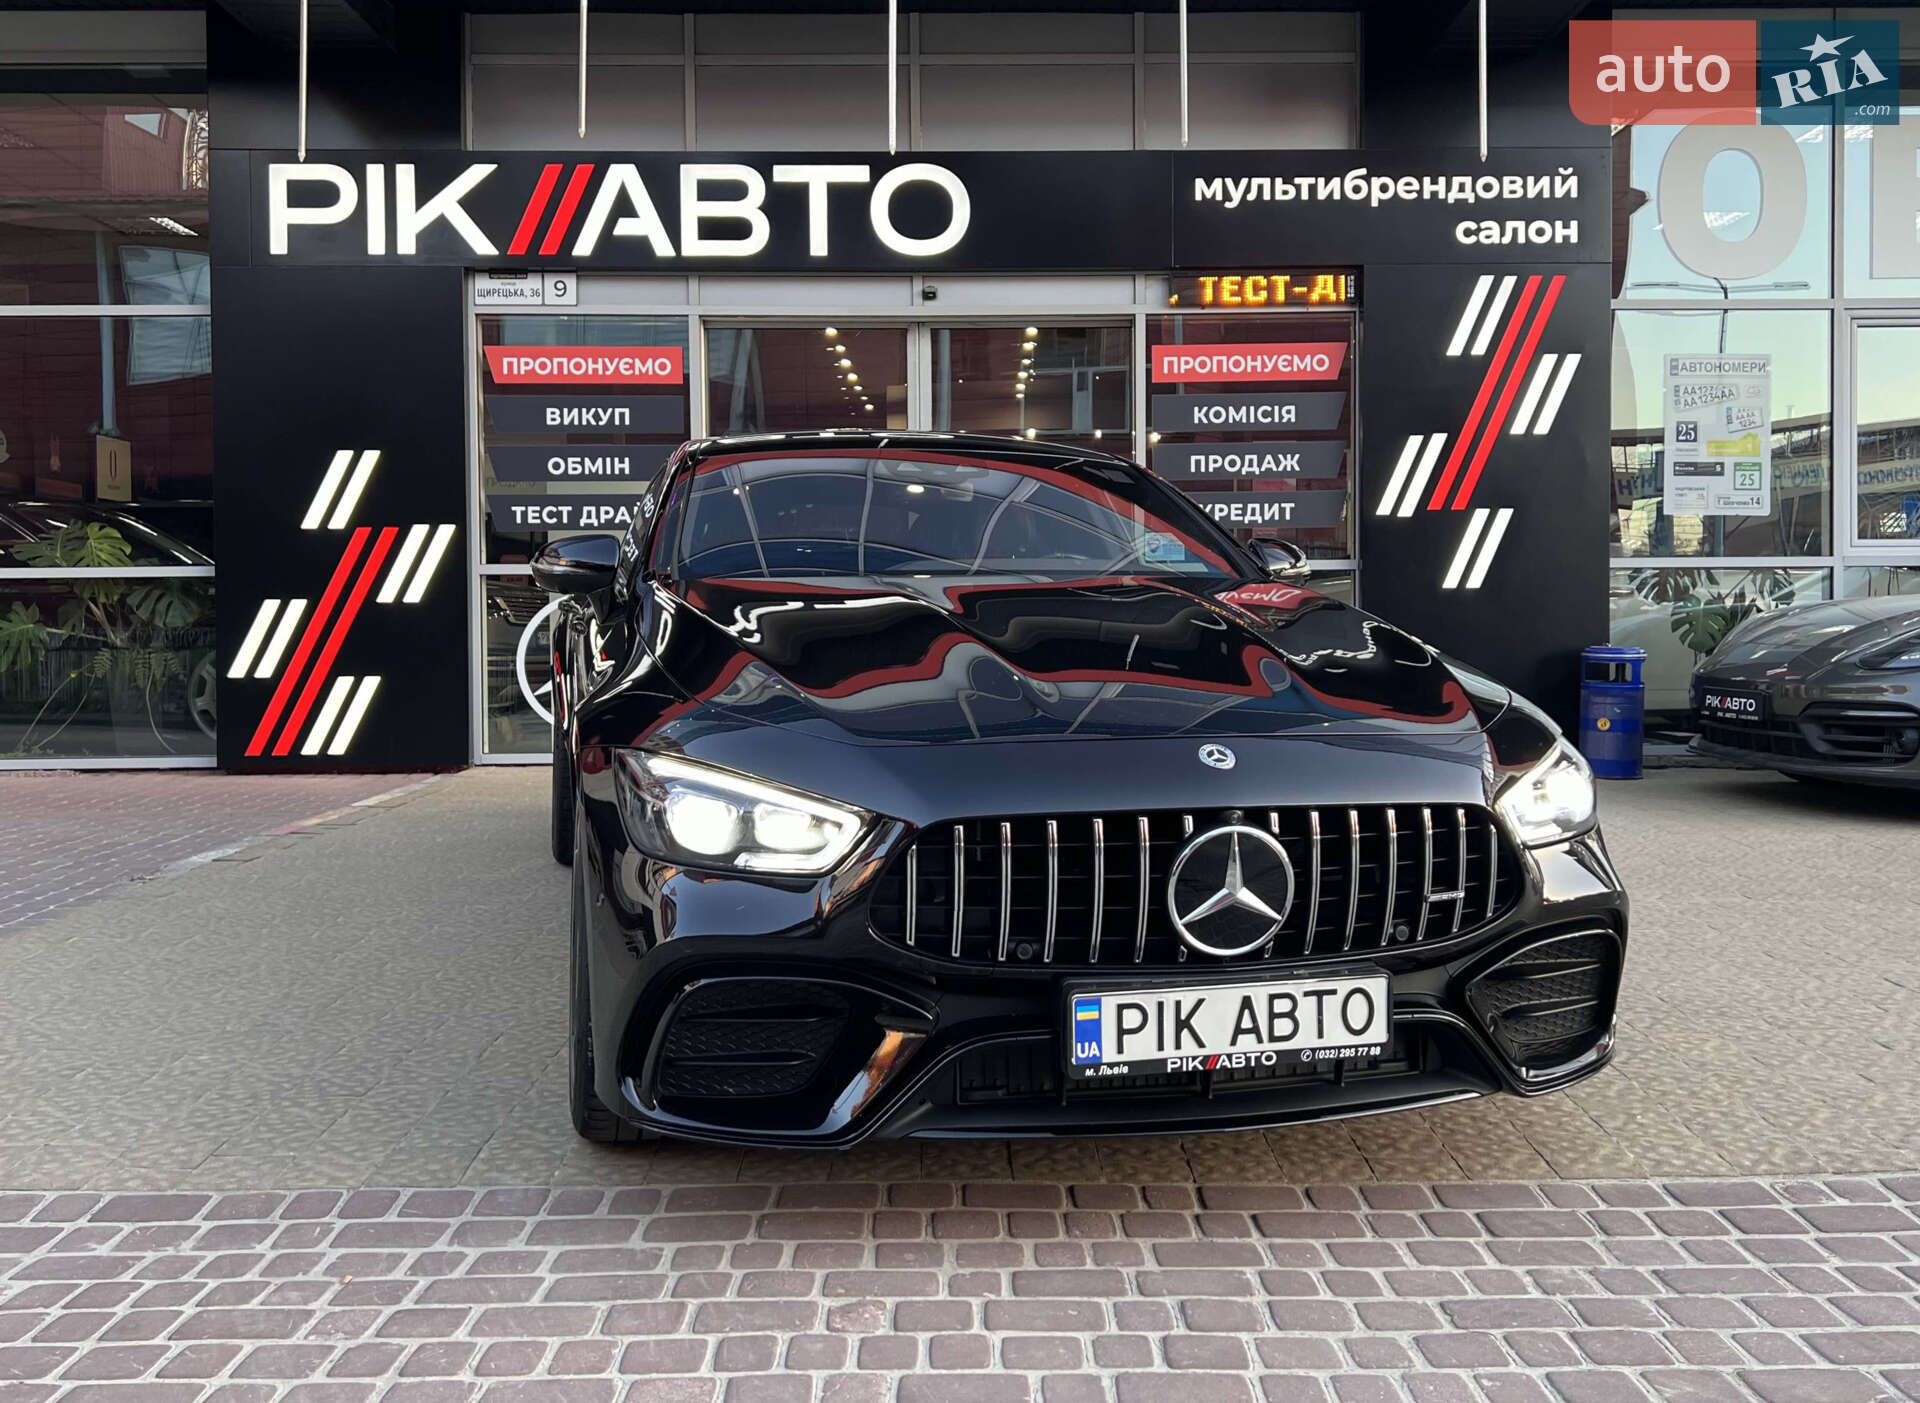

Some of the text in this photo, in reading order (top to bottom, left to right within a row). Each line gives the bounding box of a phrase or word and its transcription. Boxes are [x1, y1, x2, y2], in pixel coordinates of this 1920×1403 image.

[1194, 167, 1579, 208] мультибрендовий
[1455, 219, 1579, 246] салон
[530, 287, 541, 297] 36
[553, 280, 567, 298] 9
[502, 357, 672, 376] ПРОПОНУЄМО
[1162, 354, 1330, 374] ПРОПОНУЄМО
[1680, 361, 1766, 373] АВТОНОМЕРИ
[546, 407, 630, 425] ВИКУП
[1193, 404, 1296, 424] КОМІСІЯ
[1678, 423, 1696, 441] 25
[547, 457, 630, 475] ОБМІН
[1190, 453, 1301, 475] ПРОДАЖ
[1739, 473, 1755, 487] 25
[1750, 497, 1761, 506] 14
[511, 505, 573, 524] ТЕСТ
[1116, 986, 1375, 1055] РІК АВТО
[1077, 1042, 1100, 1058] UA
[1314, 1048, 1338, 1060] (032)
[1339, 1047, 1355, 1058] 295
[1357, 1047, 1369, 1057] 77
